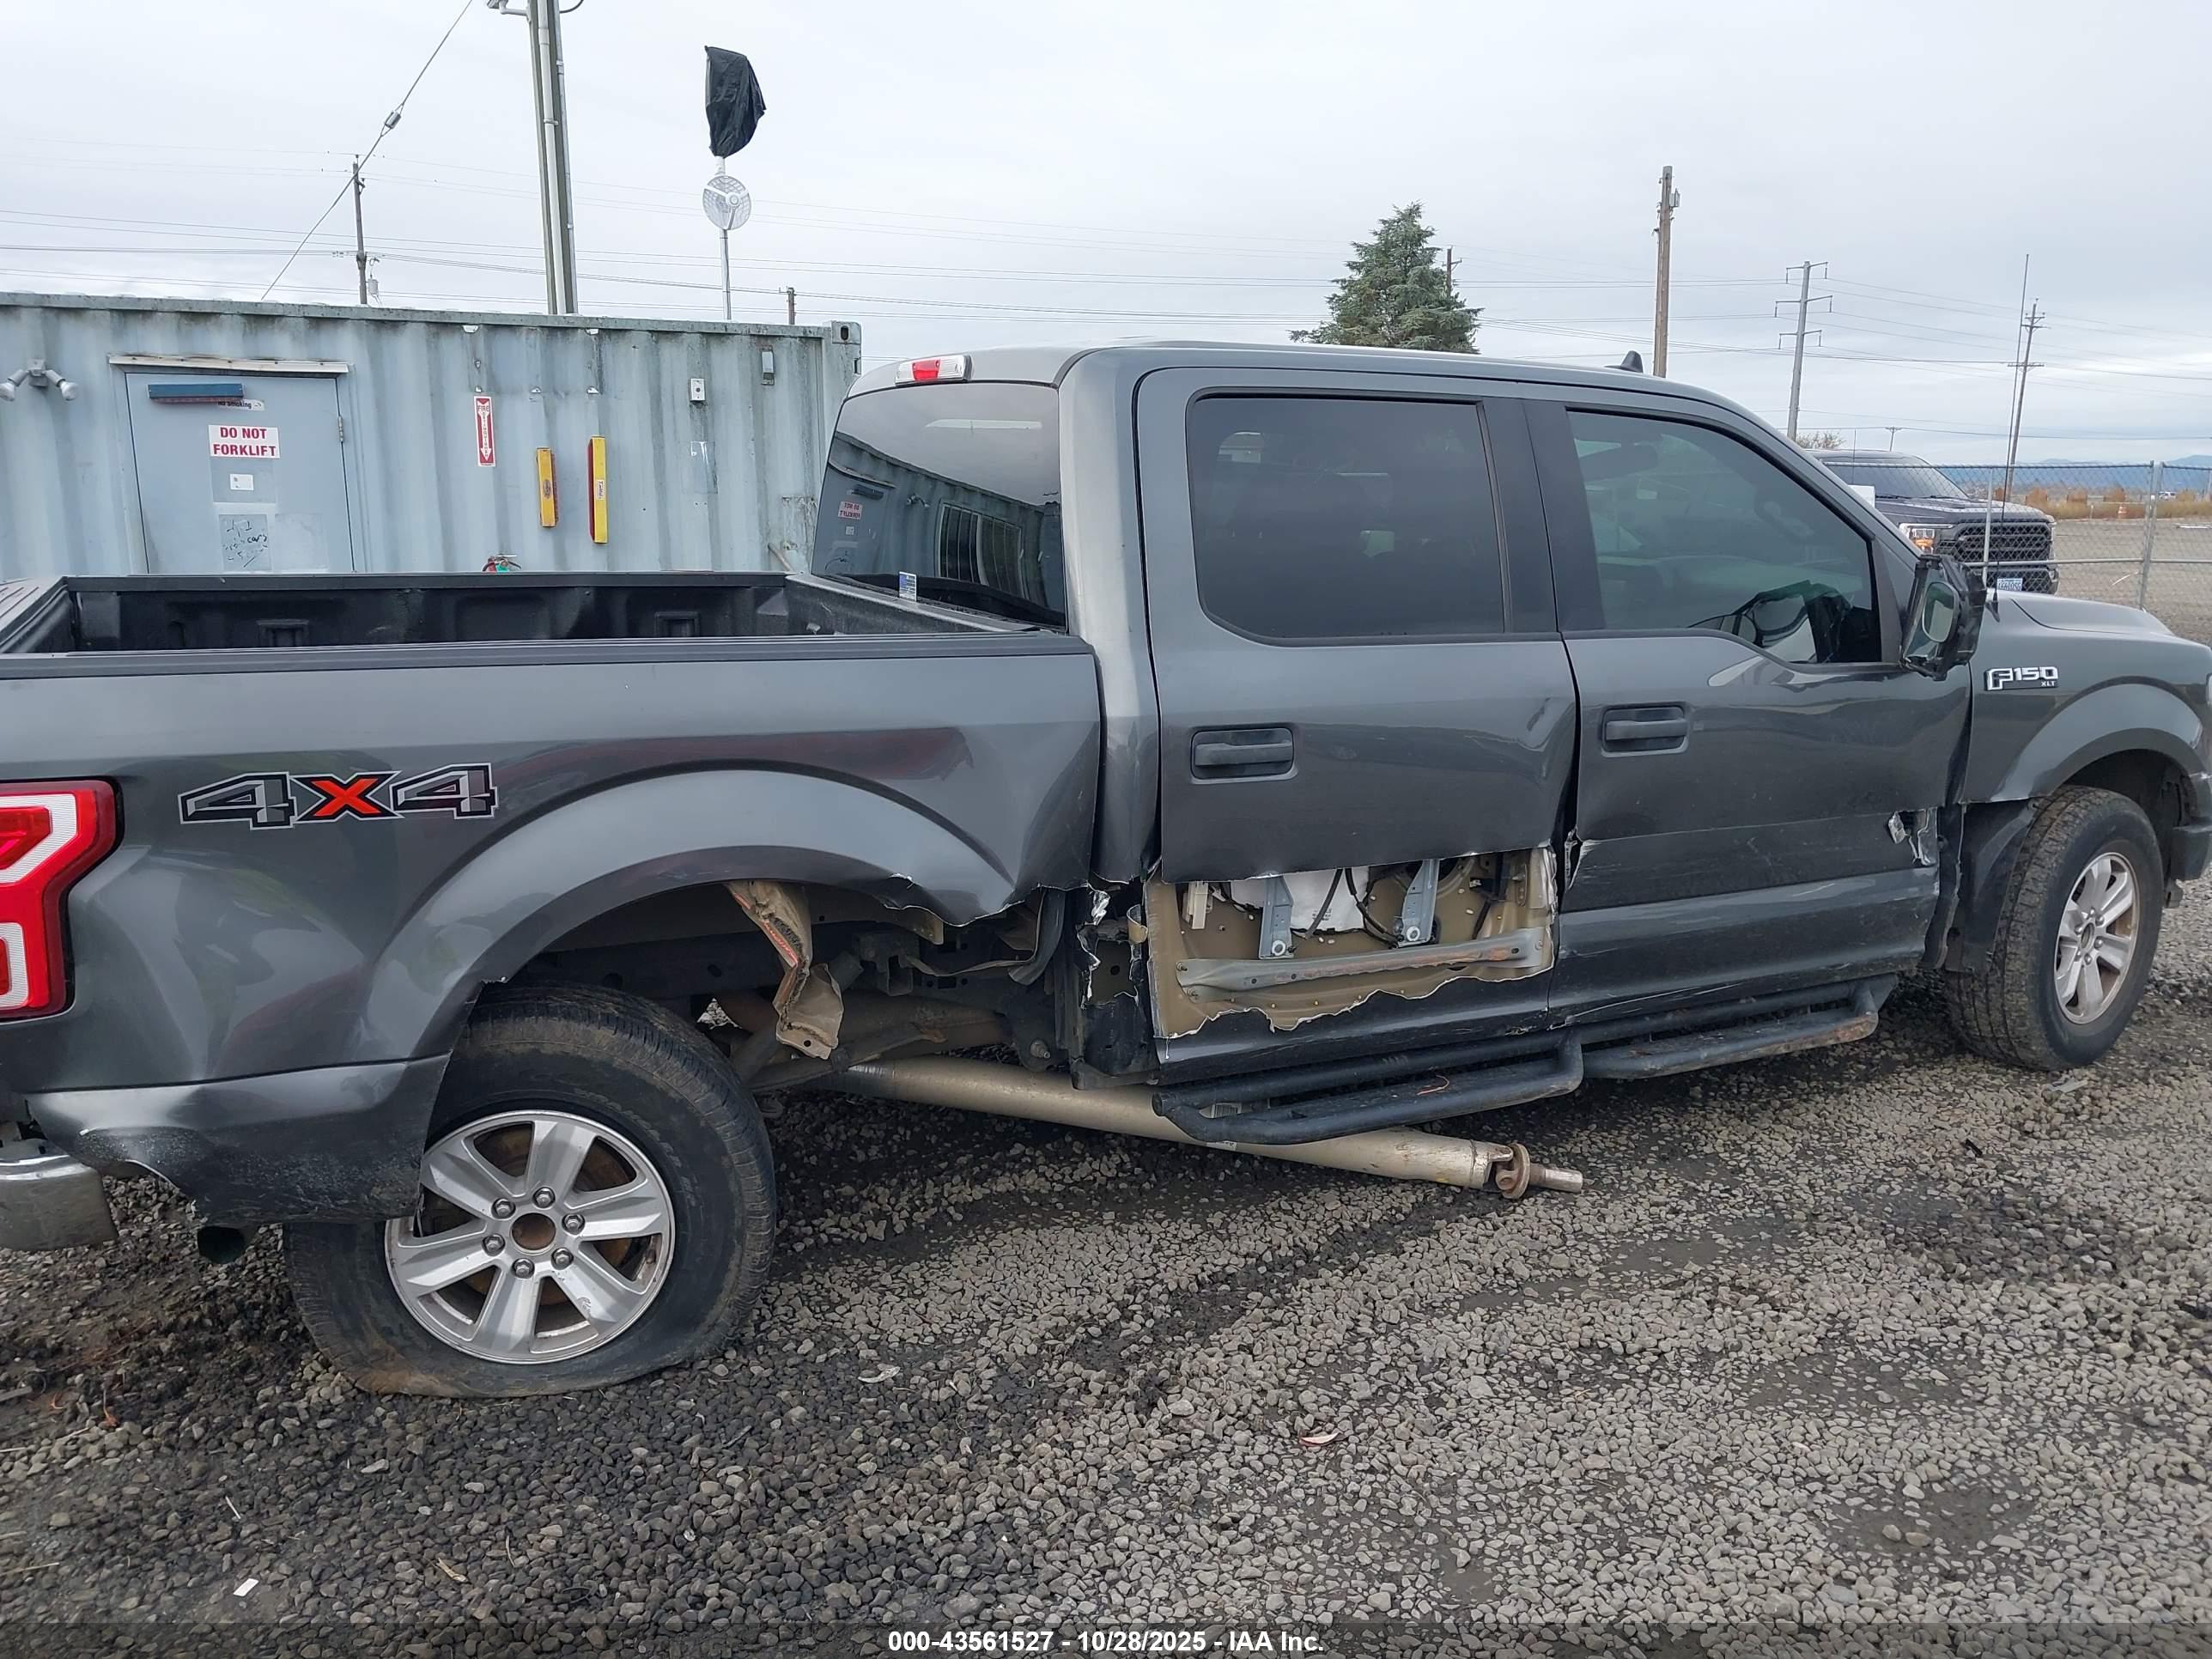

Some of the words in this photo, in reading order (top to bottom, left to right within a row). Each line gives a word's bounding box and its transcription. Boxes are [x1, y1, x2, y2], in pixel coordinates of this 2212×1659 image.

[220, 427, 238, 438] DO
[242, 428, 267, 439] NOT
[213, 443, 276, 457] FORKLIFT
